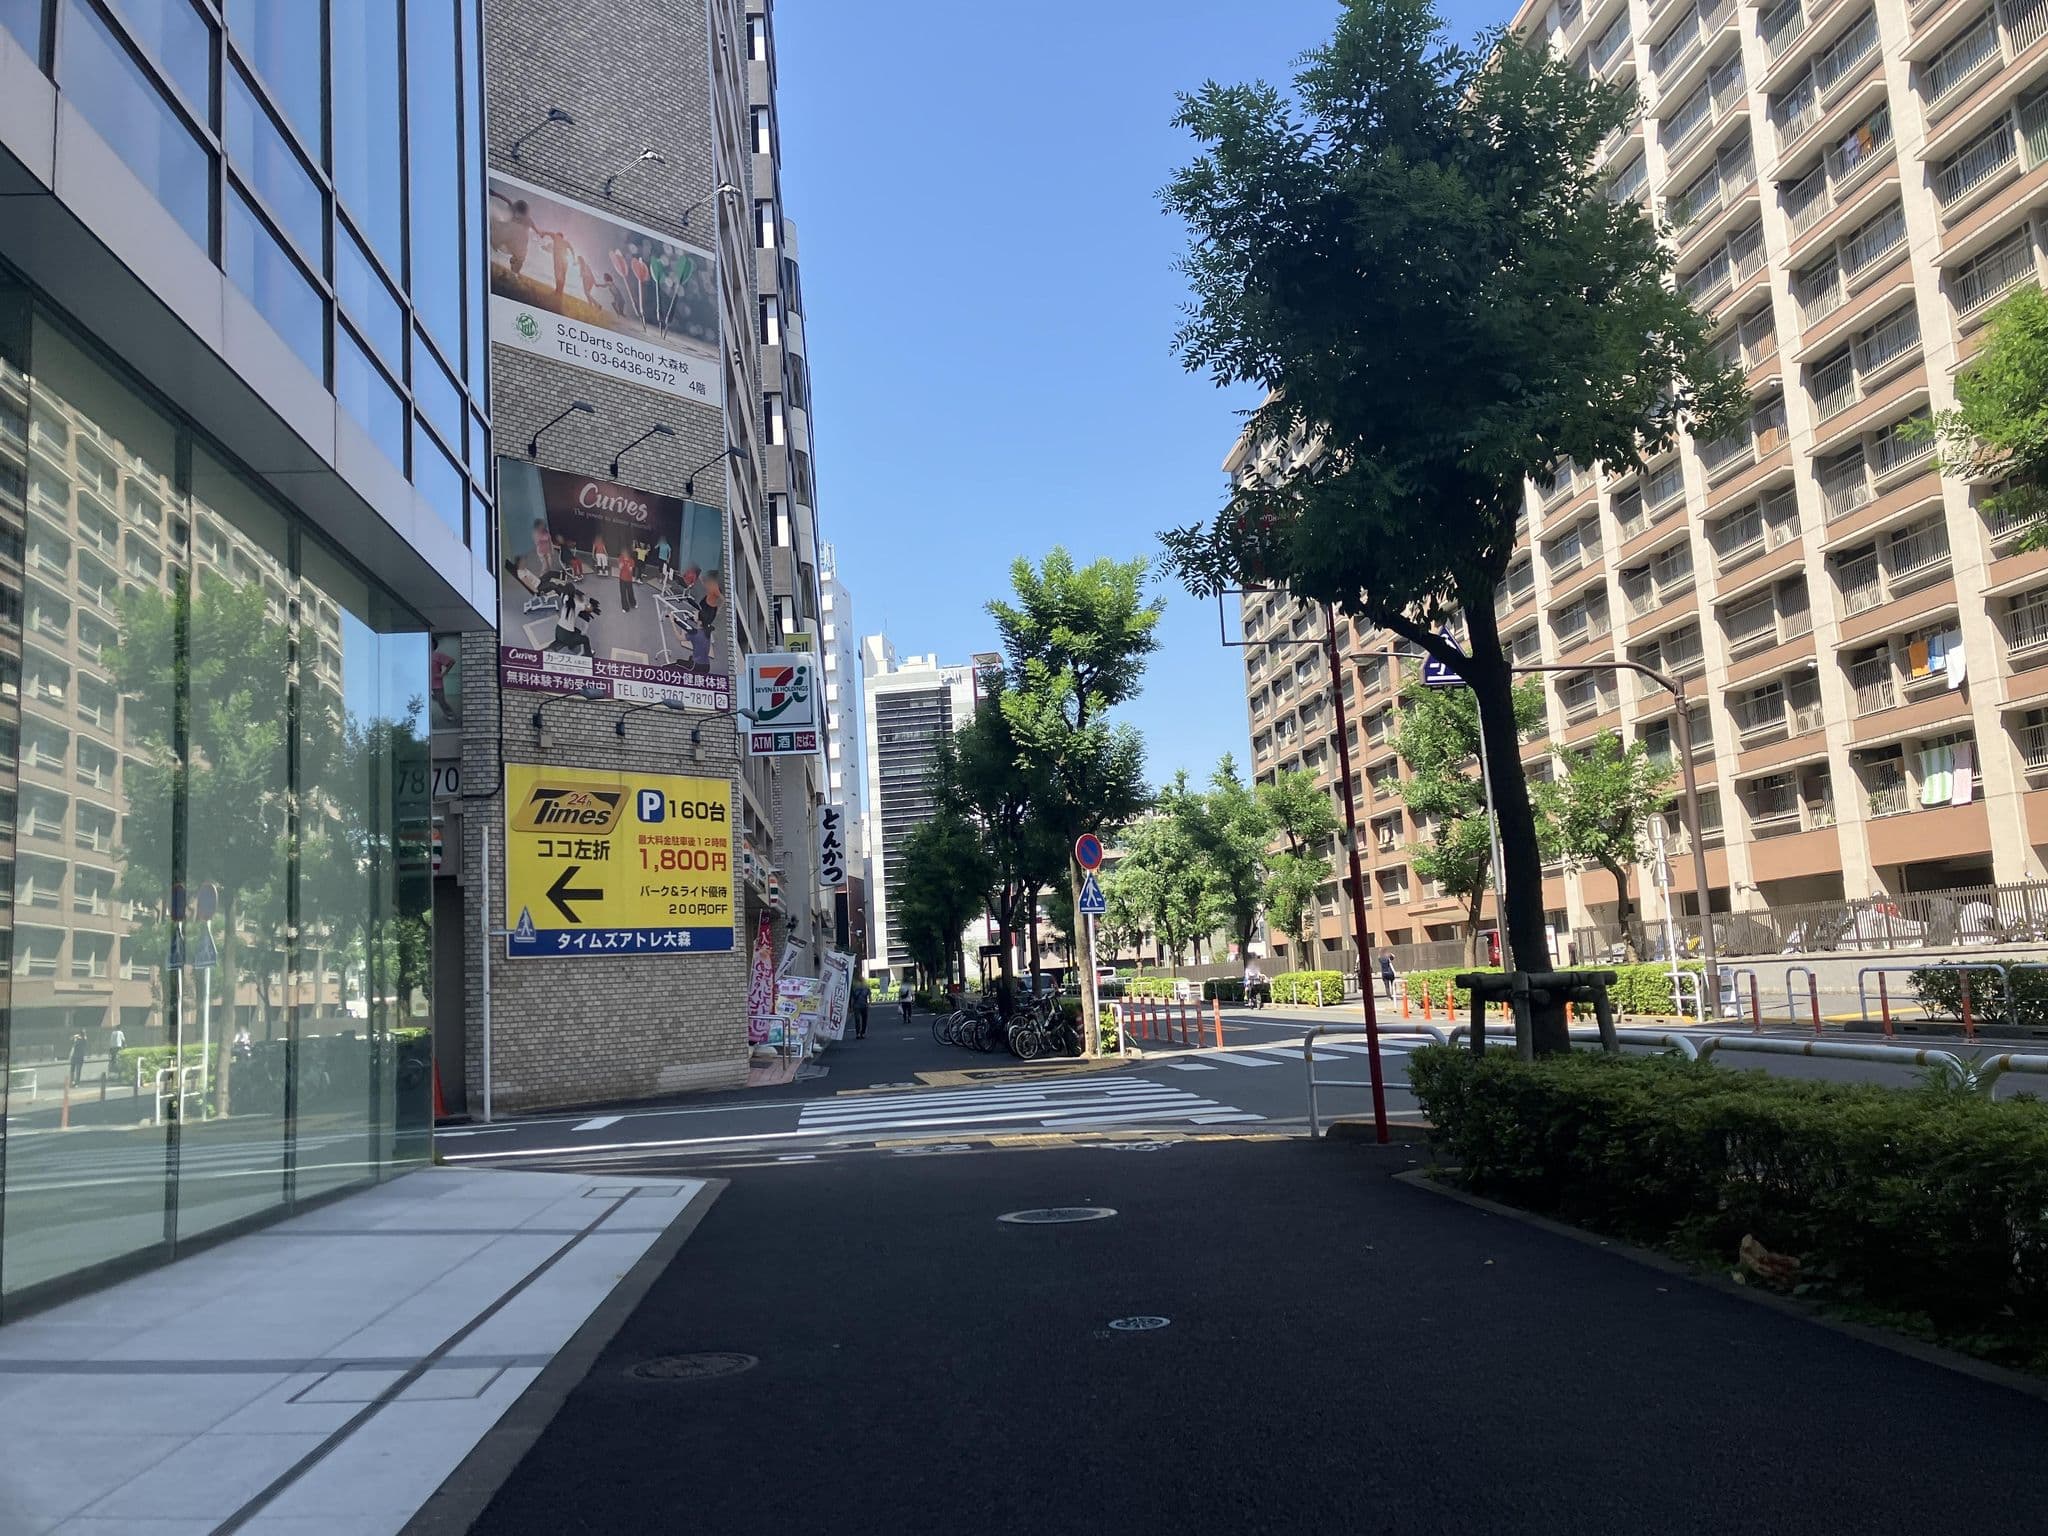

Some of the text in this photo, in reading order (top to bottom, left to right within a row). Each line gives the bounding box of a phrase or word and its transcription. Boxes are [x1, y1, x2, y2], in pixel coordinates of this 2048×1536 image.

[616, 341, 654, 363] School
[658, 355, 689, 375] 大森校
[591, 351, 675, 386] 03-6436-8572
[688, 380, 706, 396] 4階
[579, 482, 648, 522] Curves
[508, 648, 538, 663] Curves
[594, 661, 728, 690] 女性だけの30分健康体操
[642, 686, 713, 706] 03-3767-7870
[753, 734, 816, 750] ATM 酒 たばこ
[533, 796, 613, 825] Times
[642, 791, 725, 822] P 160台
[537, 838, 610, 861] ココ左折
[822, 808, 844, 882] とんかつ
[639, 848, 727, 872] 1,800円
[669, 903, 728, 915] 200円OFF
[557, 931, 691, 949] タイムズアトレ大森
